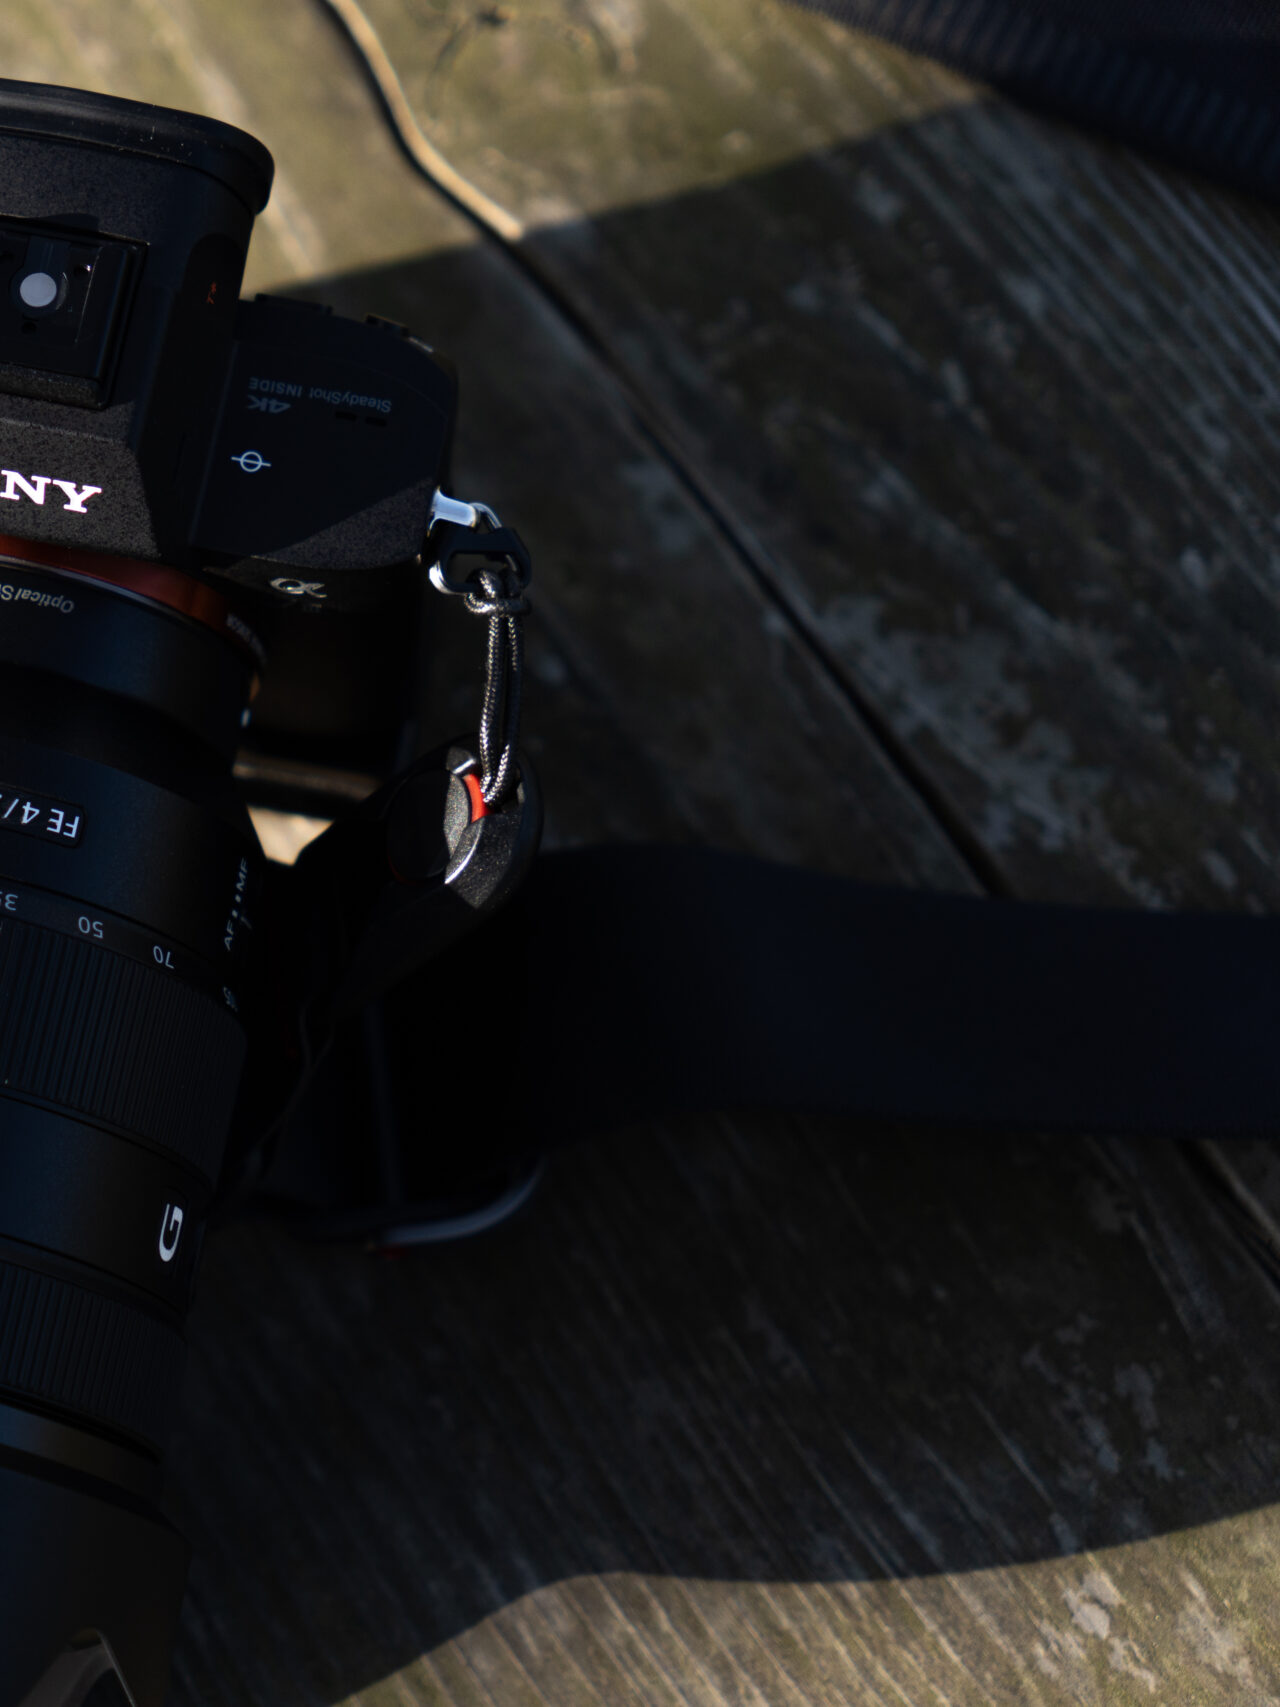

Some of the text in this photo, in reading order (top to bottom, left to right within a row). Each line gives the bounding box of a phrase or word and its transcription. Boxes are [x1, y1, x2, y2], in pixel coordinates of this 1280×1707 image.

[245, 394, 292, 415] 4K
[248, 376, 393, 414] SteadyShot INSIDE
[14, 587, 75, 614] Optical
[46, 808, 81, 838] FE
[223, 856, 249, 952] AF MF
[78, 915, 104, 939] 50
[152, 944, 176, 970] 70
[158, 1203, 184, 1263] G
